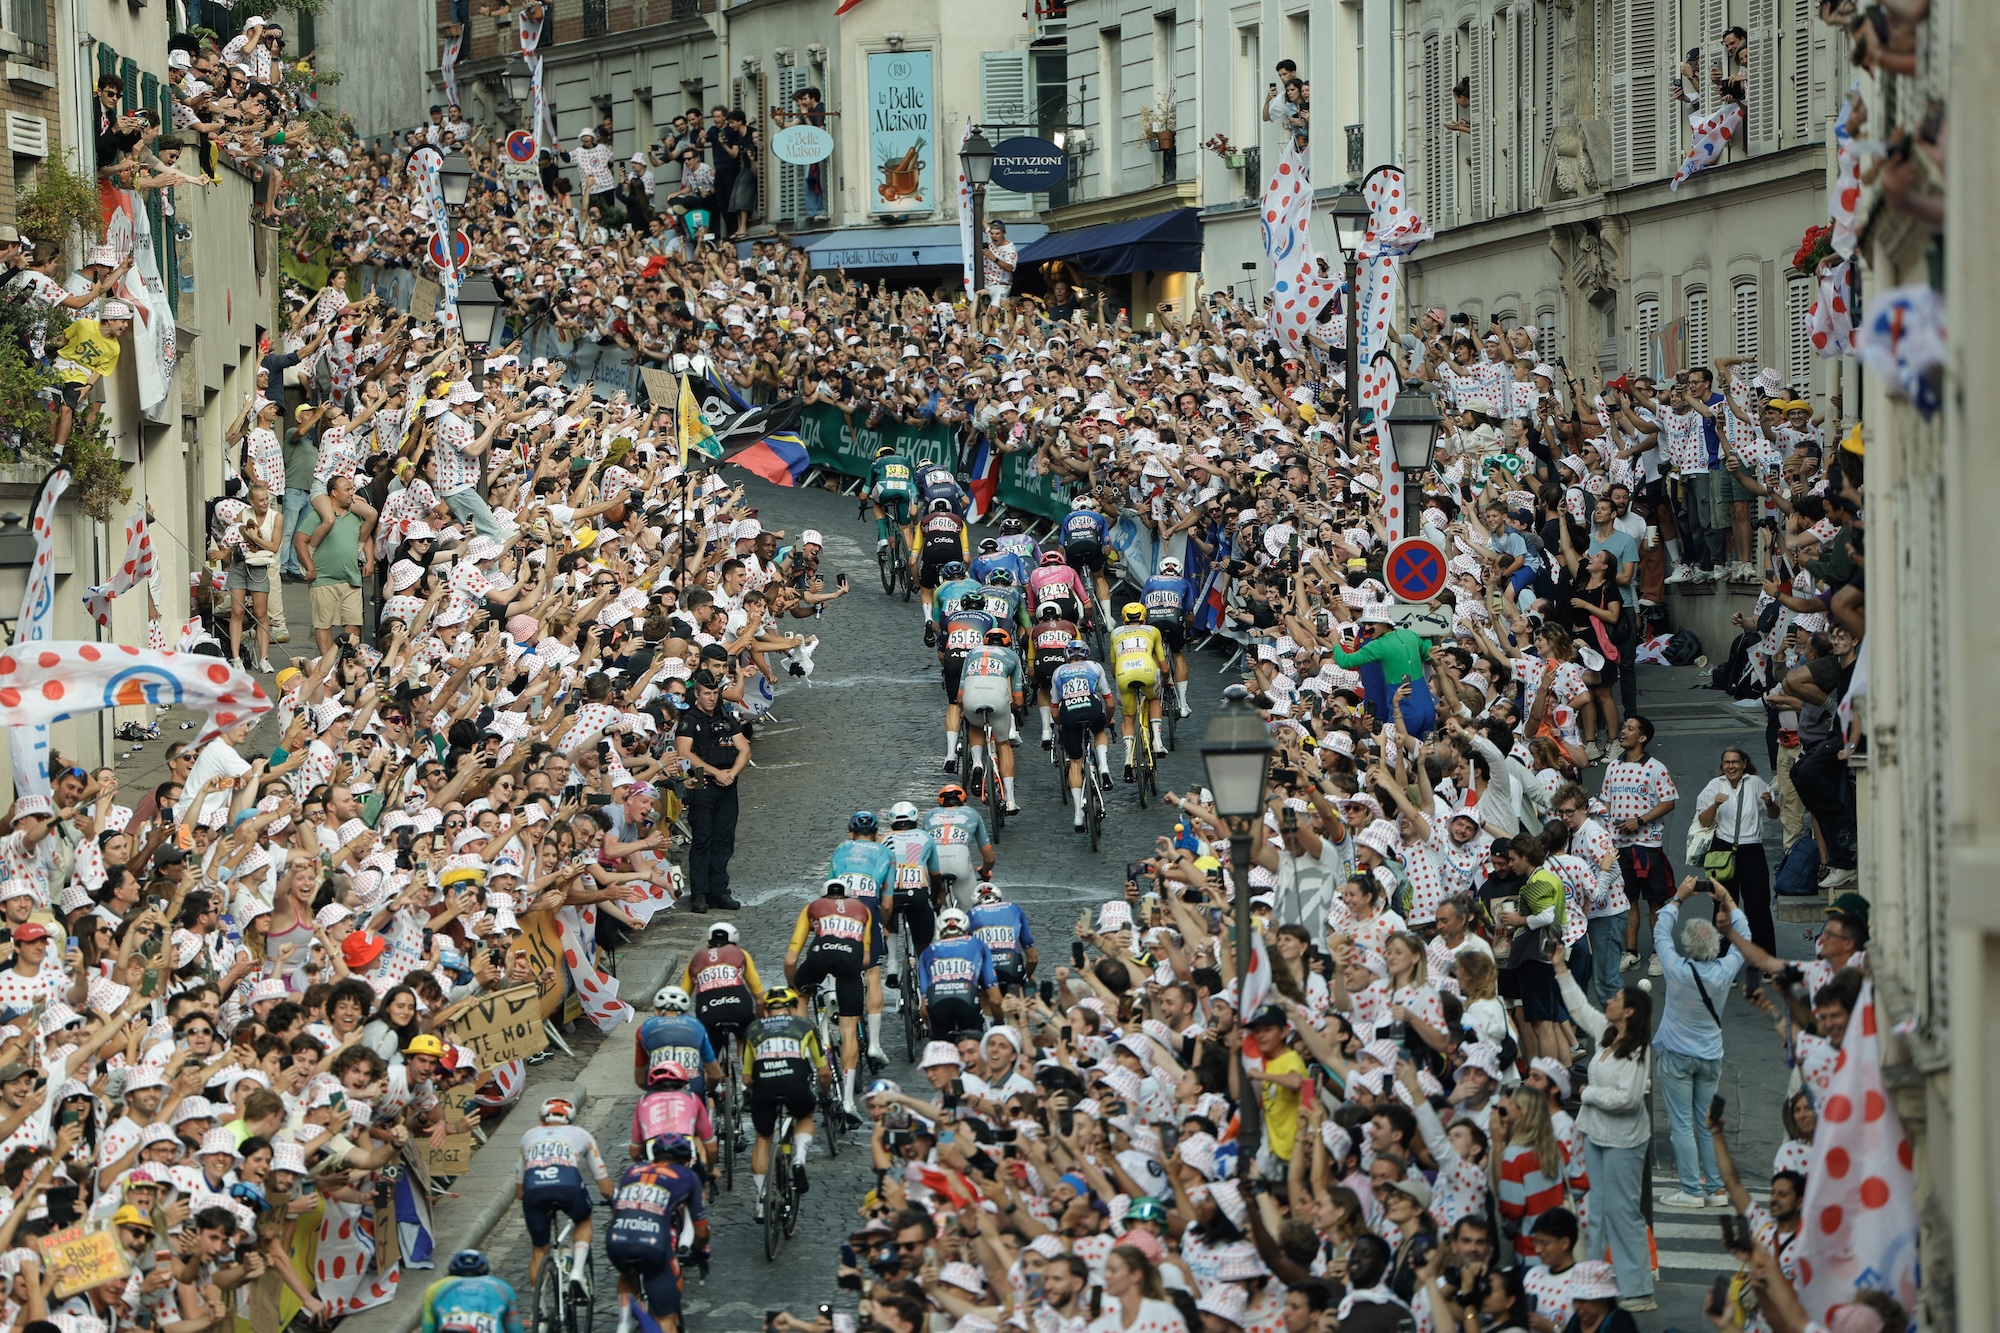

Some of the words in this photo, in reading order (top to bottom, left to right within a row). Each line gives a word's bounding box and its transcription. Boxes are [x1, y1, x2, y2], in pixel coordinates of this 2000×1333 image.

[889, 86, 924, 110] Belle
[876, 109, 927, 132] Maison
[795, 132, 818, 145] Belle
[786, 145, 821, 158] Maison
[841, 251, 863, 265] Belle
[866, 249, 898, 264] Maison
[888, 465, 897, 475] 33
[948, 600, 960, 611] 62
[993, 599, 1006, 612] 94
[951, 631, 963, 644] 55
[970, 631, 981, 644] 55
[1135, 637, 1140, 648] 1
[989, 659, 1001, 670] 87
[1064, 681, 1075, 695] 28
[1076, 679, 1088, 692] 28
[1065, 696, 1091, 707] BORA
[952, 828, 966, 841] 88
[903, 868, 922, 883] 131
[859, 877, 874, 891] 66
[823, 918, 841, 931] 167
[994, 929, 1014, 942] 108
[822, 942, 853, 954] Cofidis
[699, 967, 716, 984] 163
[717, 966, 737, 979] 163
[932, 961, 953, 977] 104
[953, 960, 974, 974] 104
[709, 996, 741, 1007] Cofidis
[502, 1019, 532, 1044] MOI
[760, 1040, 771, 1054] 14
[782, 1039, 794, 1052] 14
[675, 1051, 699, 1069] 188
[763, 1060, 788, 1070] VISMA
[649, 1100, 685, 1124] EF
[429, 1149, 460, 1165] POGI
[623, 1216, 660, 1234] raisin
[65, 1241, 99, 1264] Baby
